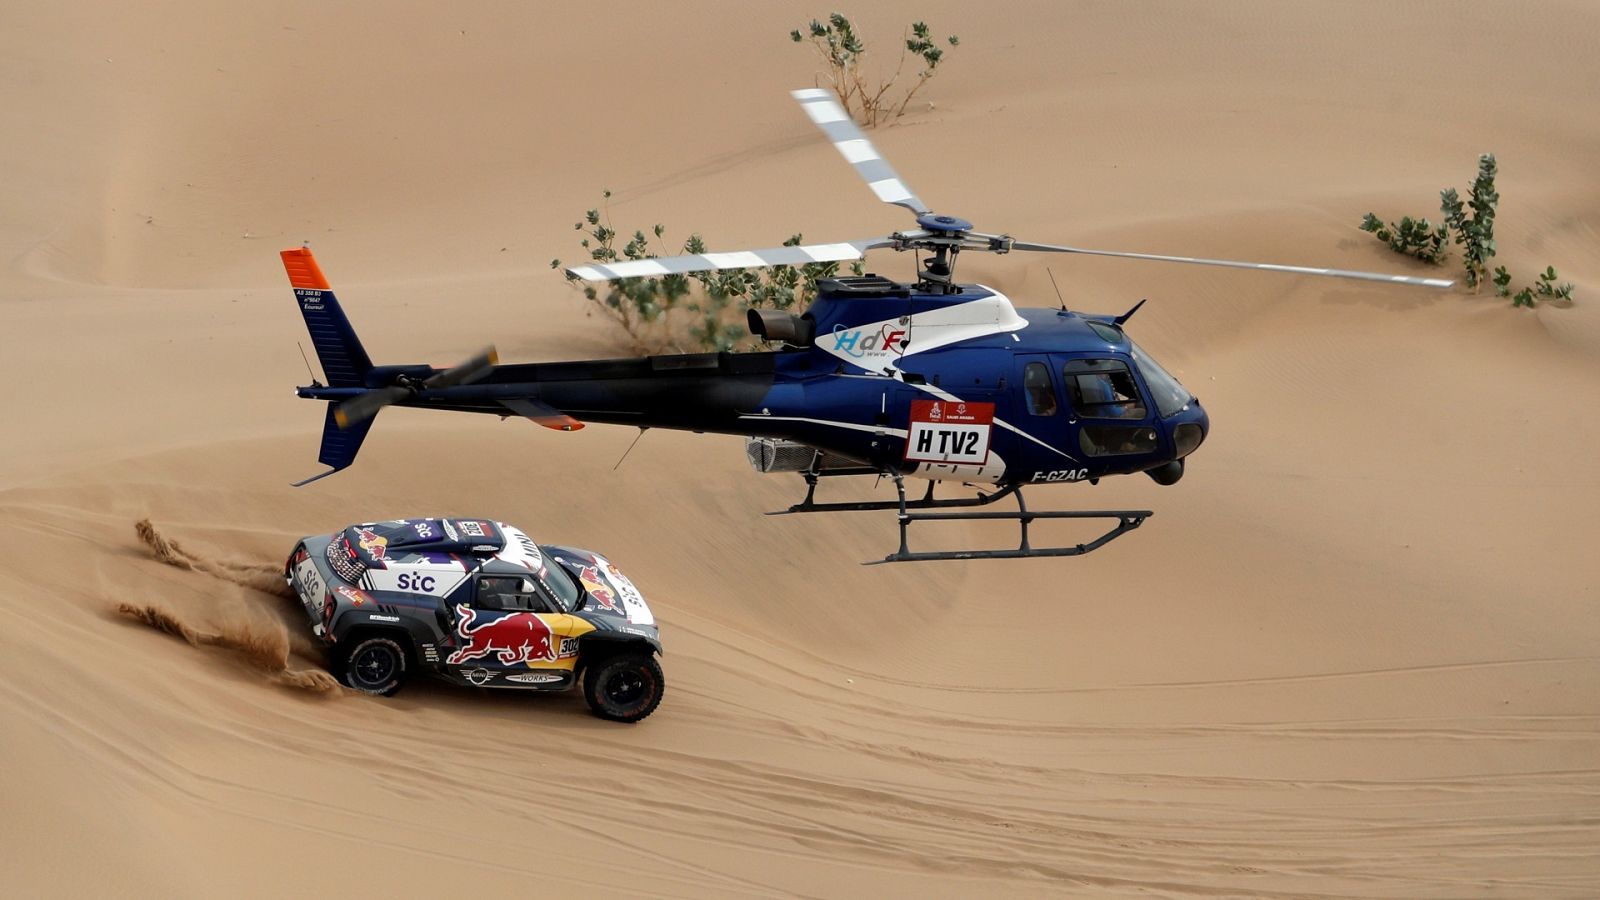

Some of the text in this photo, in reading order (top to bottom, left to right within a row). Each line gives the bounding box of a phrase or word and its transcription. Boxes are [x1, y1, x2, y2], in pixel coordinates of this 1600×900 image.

[833, 330, 906, 350] HdF
[916, 430, 979, 455] H TV2
[1030, 468, 1088, 482] F-GZAC
[304, 569, 319, 596] stc
[397, 571, 436, 592] stc
[562, 640, 578, 652] 302
[520, 673, 548, 682] WORKS
